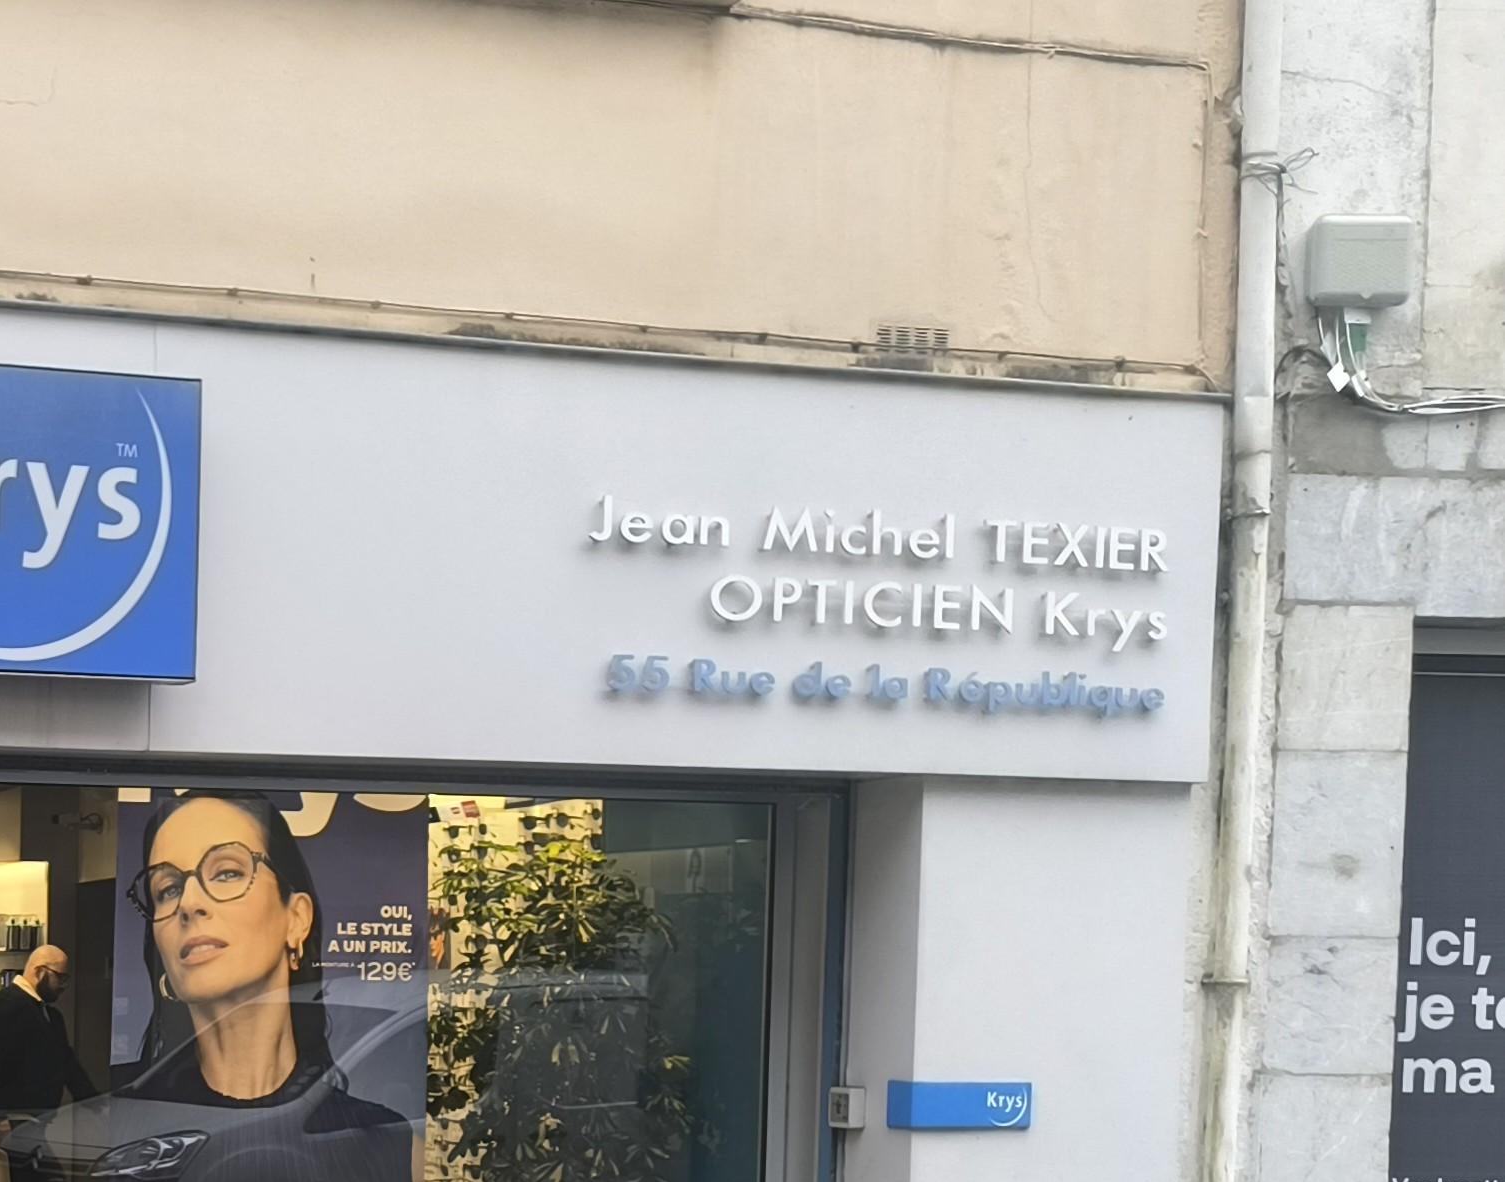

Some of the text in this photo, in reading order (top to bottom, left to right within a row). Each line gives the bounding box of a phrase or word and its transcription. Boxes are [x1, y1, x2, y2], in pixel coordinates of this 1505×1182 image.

[589, 495, 1169, 571] Jean Michel TEXIER
[710, 574, 1168, 652] OPTICIEN Krys
[607, 654, 1165, 718] 55 Rue de la République
[337, 922, 412, 936] LE STYLE
[380, 905, 413, 920] OUI,
[343, 940, 366, 953] UN
[370, 940, 412, 953] PRIX.
[1409, 917, 1492, 975] Ici,
[1397, 981, 1454, 1042] je
[1402, 1057, 1495, 1093] ma
[987, 1091, 1023, 1112] Krys
